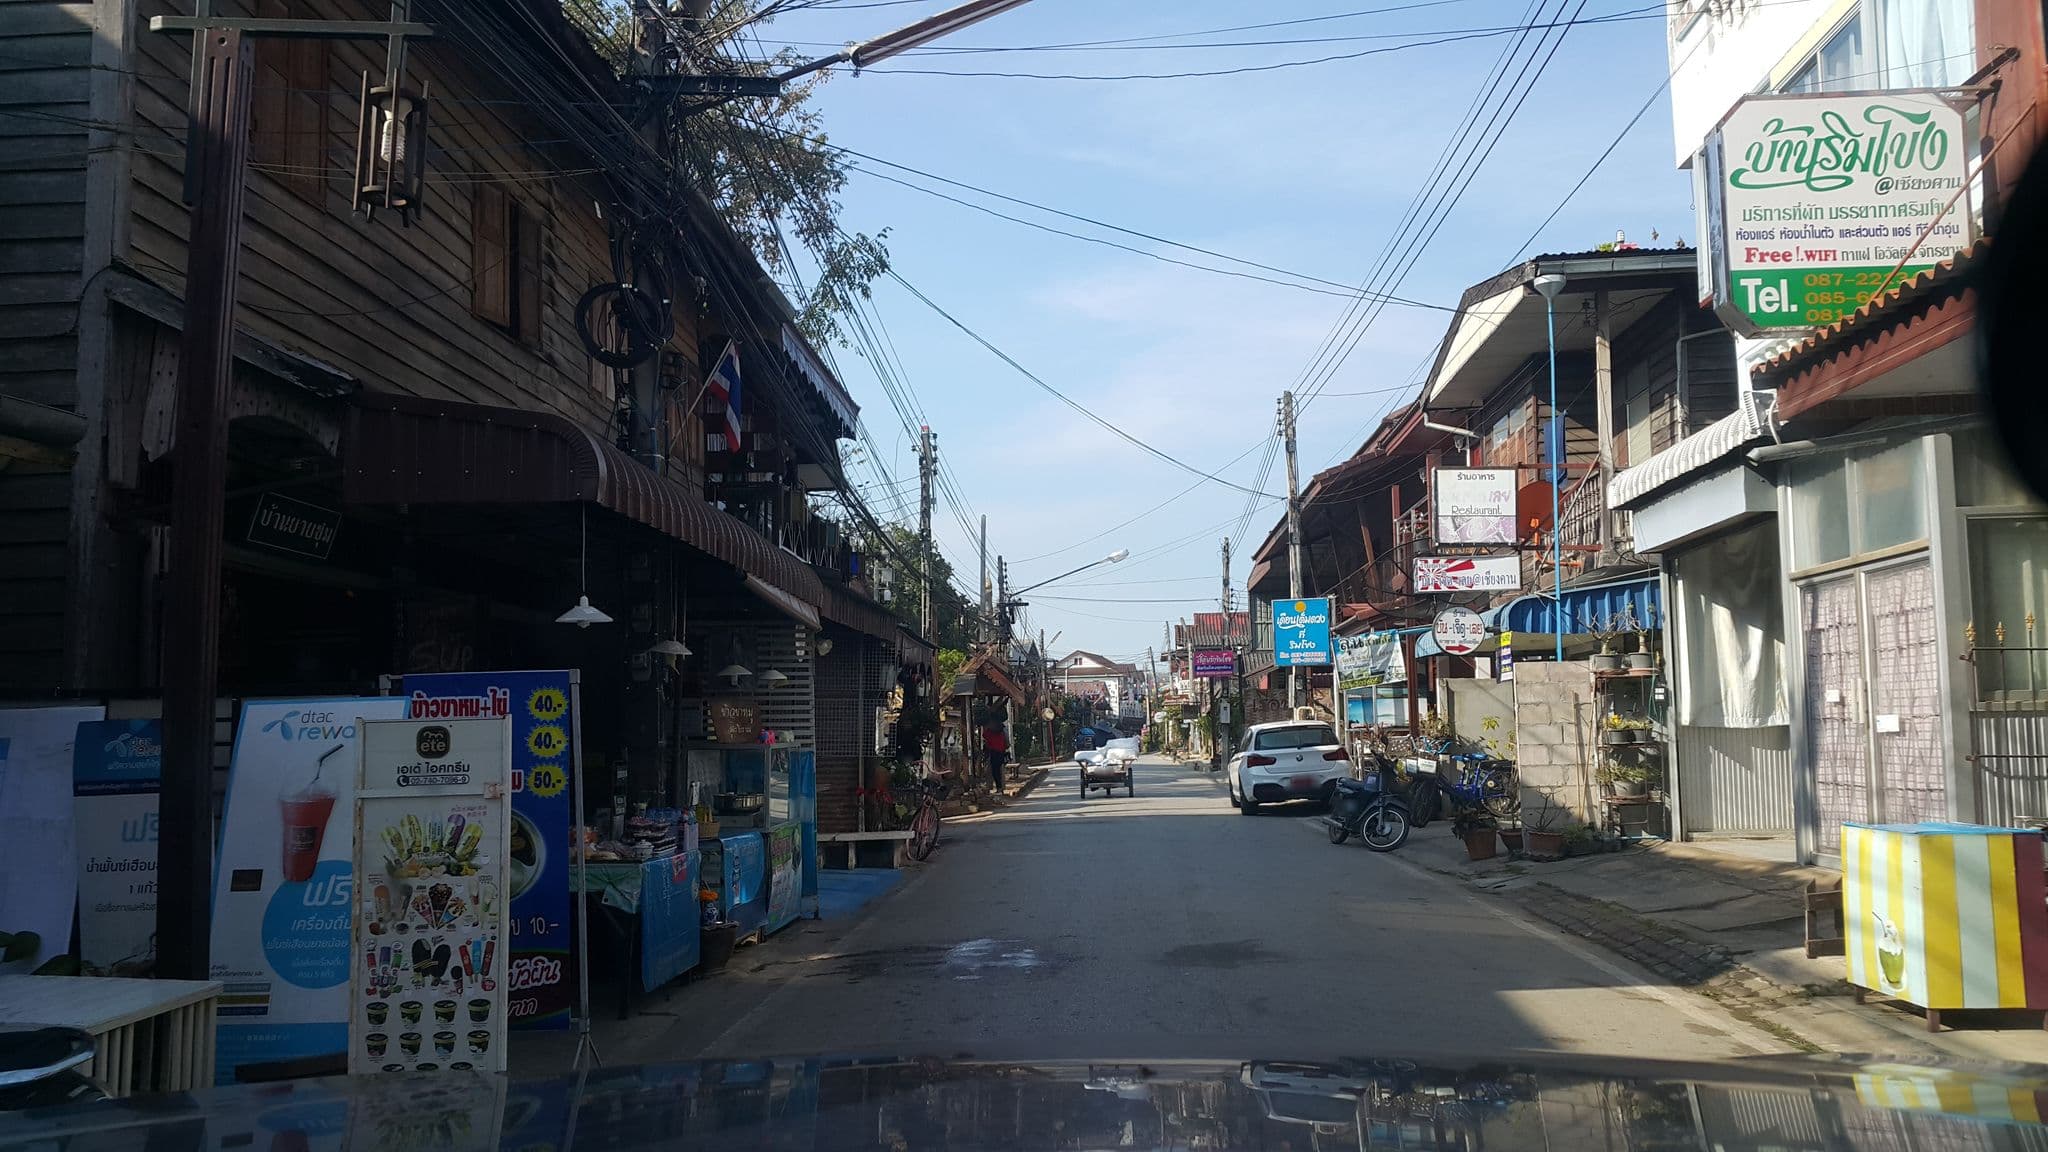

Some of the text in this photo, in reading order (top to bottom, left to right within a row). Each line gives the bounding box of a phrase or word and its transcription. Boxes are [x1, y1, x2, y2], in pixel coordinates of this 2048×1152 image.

[1743, 202, 1824, 221] บริการที่พัก
[1736, 227, 1775, 241] ห้องแอร์
[1780, 224, 1834, 240] ห้องน้ำในตัว
[1839, 224, 1889, 239] และส่วนตัว
[1892, 224, 1912, 237] แอร์
[1841, 247, 1871, 261] กาแฟ
[1740, 278, 1799, 314] Tel.
[1457, 471, 1496, 481] ร้านอาหาร
[1451, 504, 1503, 515] Restaurant
[301, 710, 334, 724] dtac
[420, 736, 446, 753] ete
[424, 761, 470, 774] ไอศกรีม
